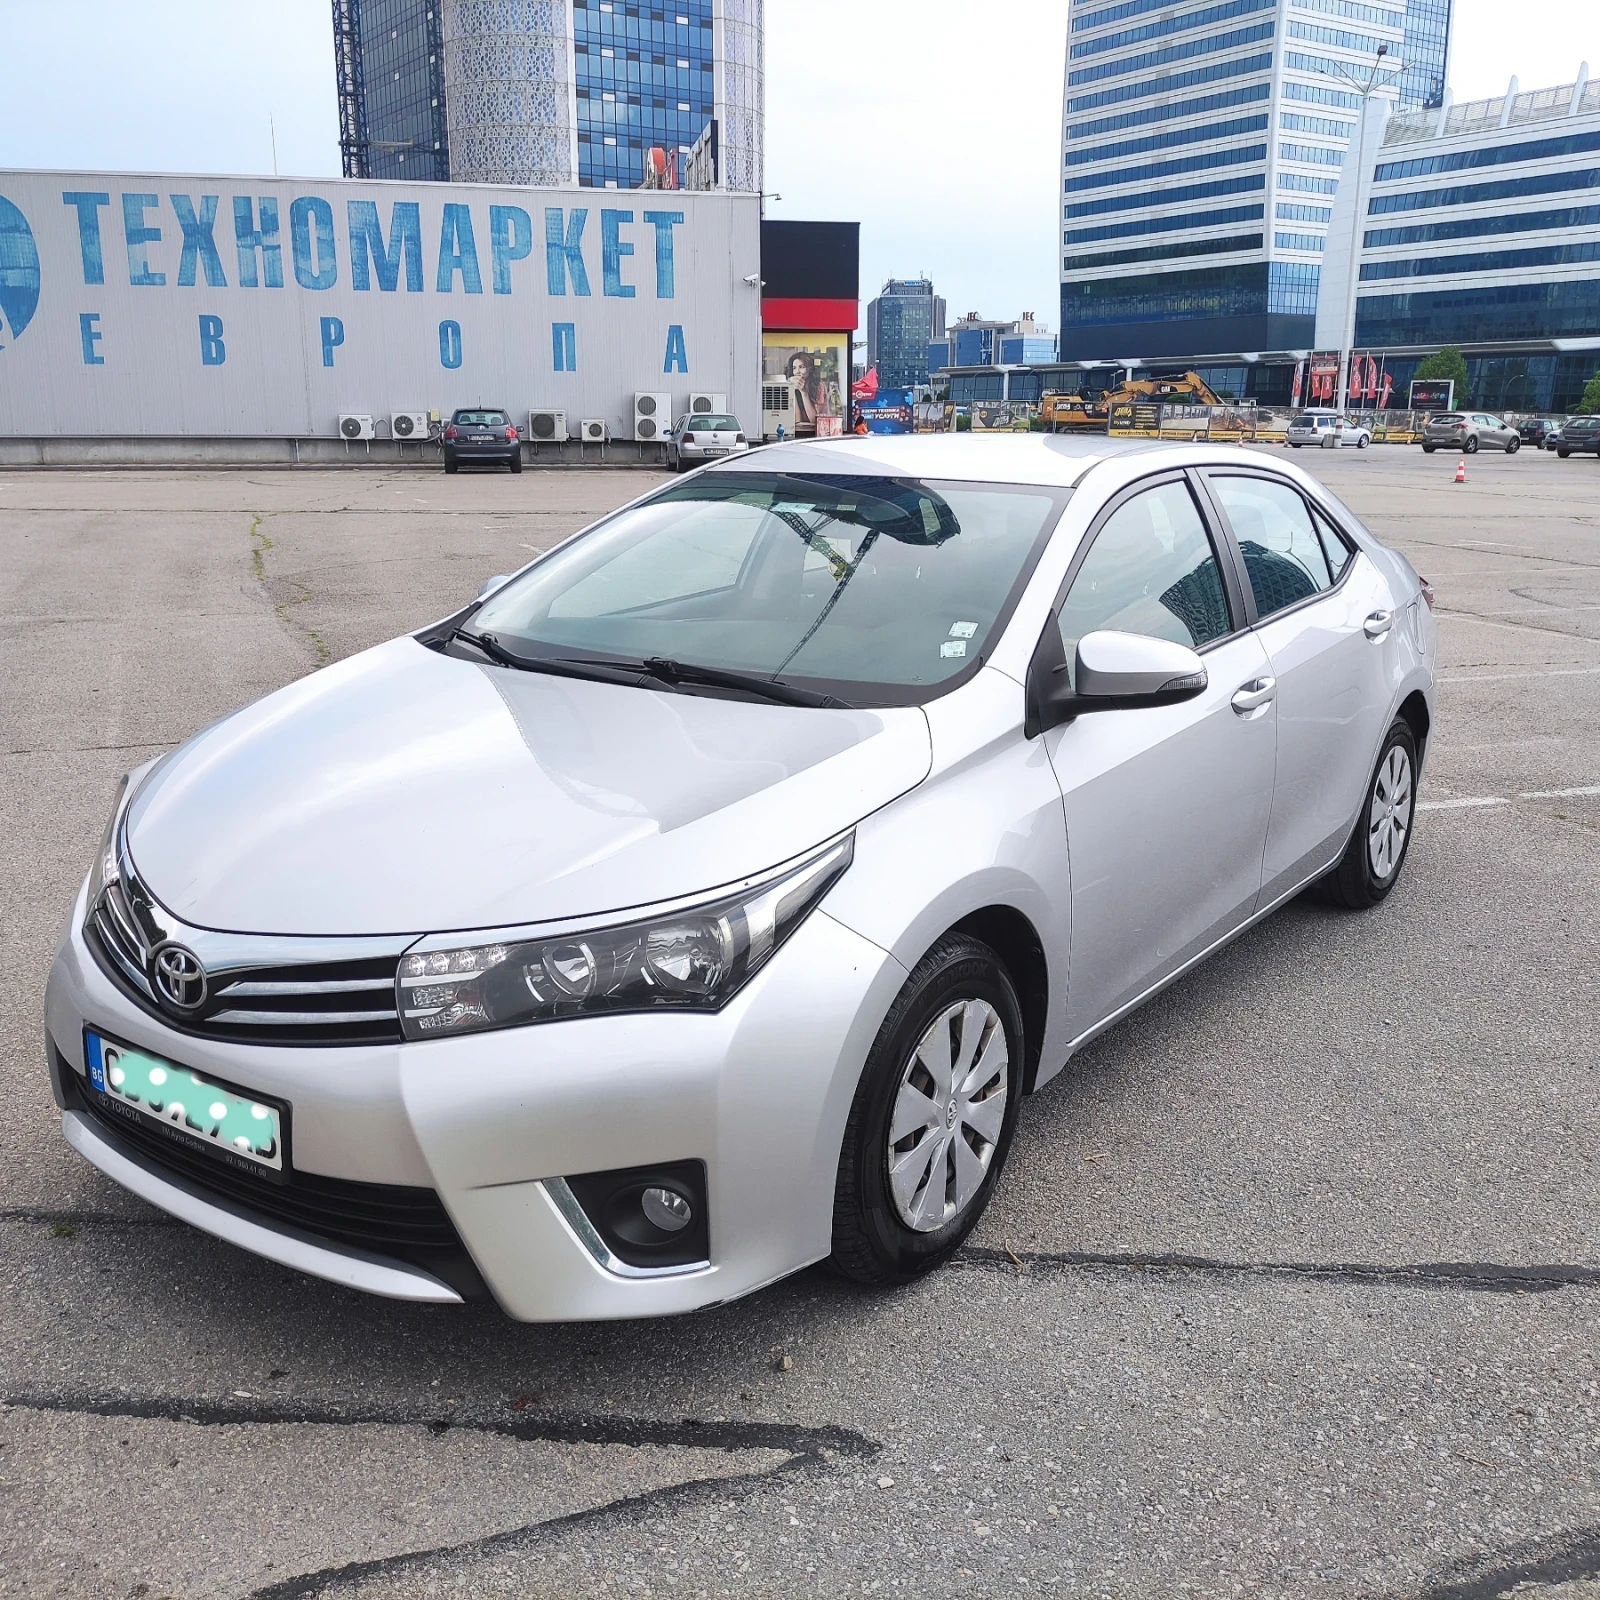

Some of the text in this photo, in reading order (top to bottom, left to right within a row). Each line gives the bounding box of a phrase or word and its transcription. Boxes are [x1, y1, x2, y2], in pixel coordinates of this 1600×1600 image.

[62, 191, 684, 298] ТЕХНОМАРКЕТ
[92, 1067, 103, 1082] BG
[110, 1099, 142, 1123] TOYOTA
